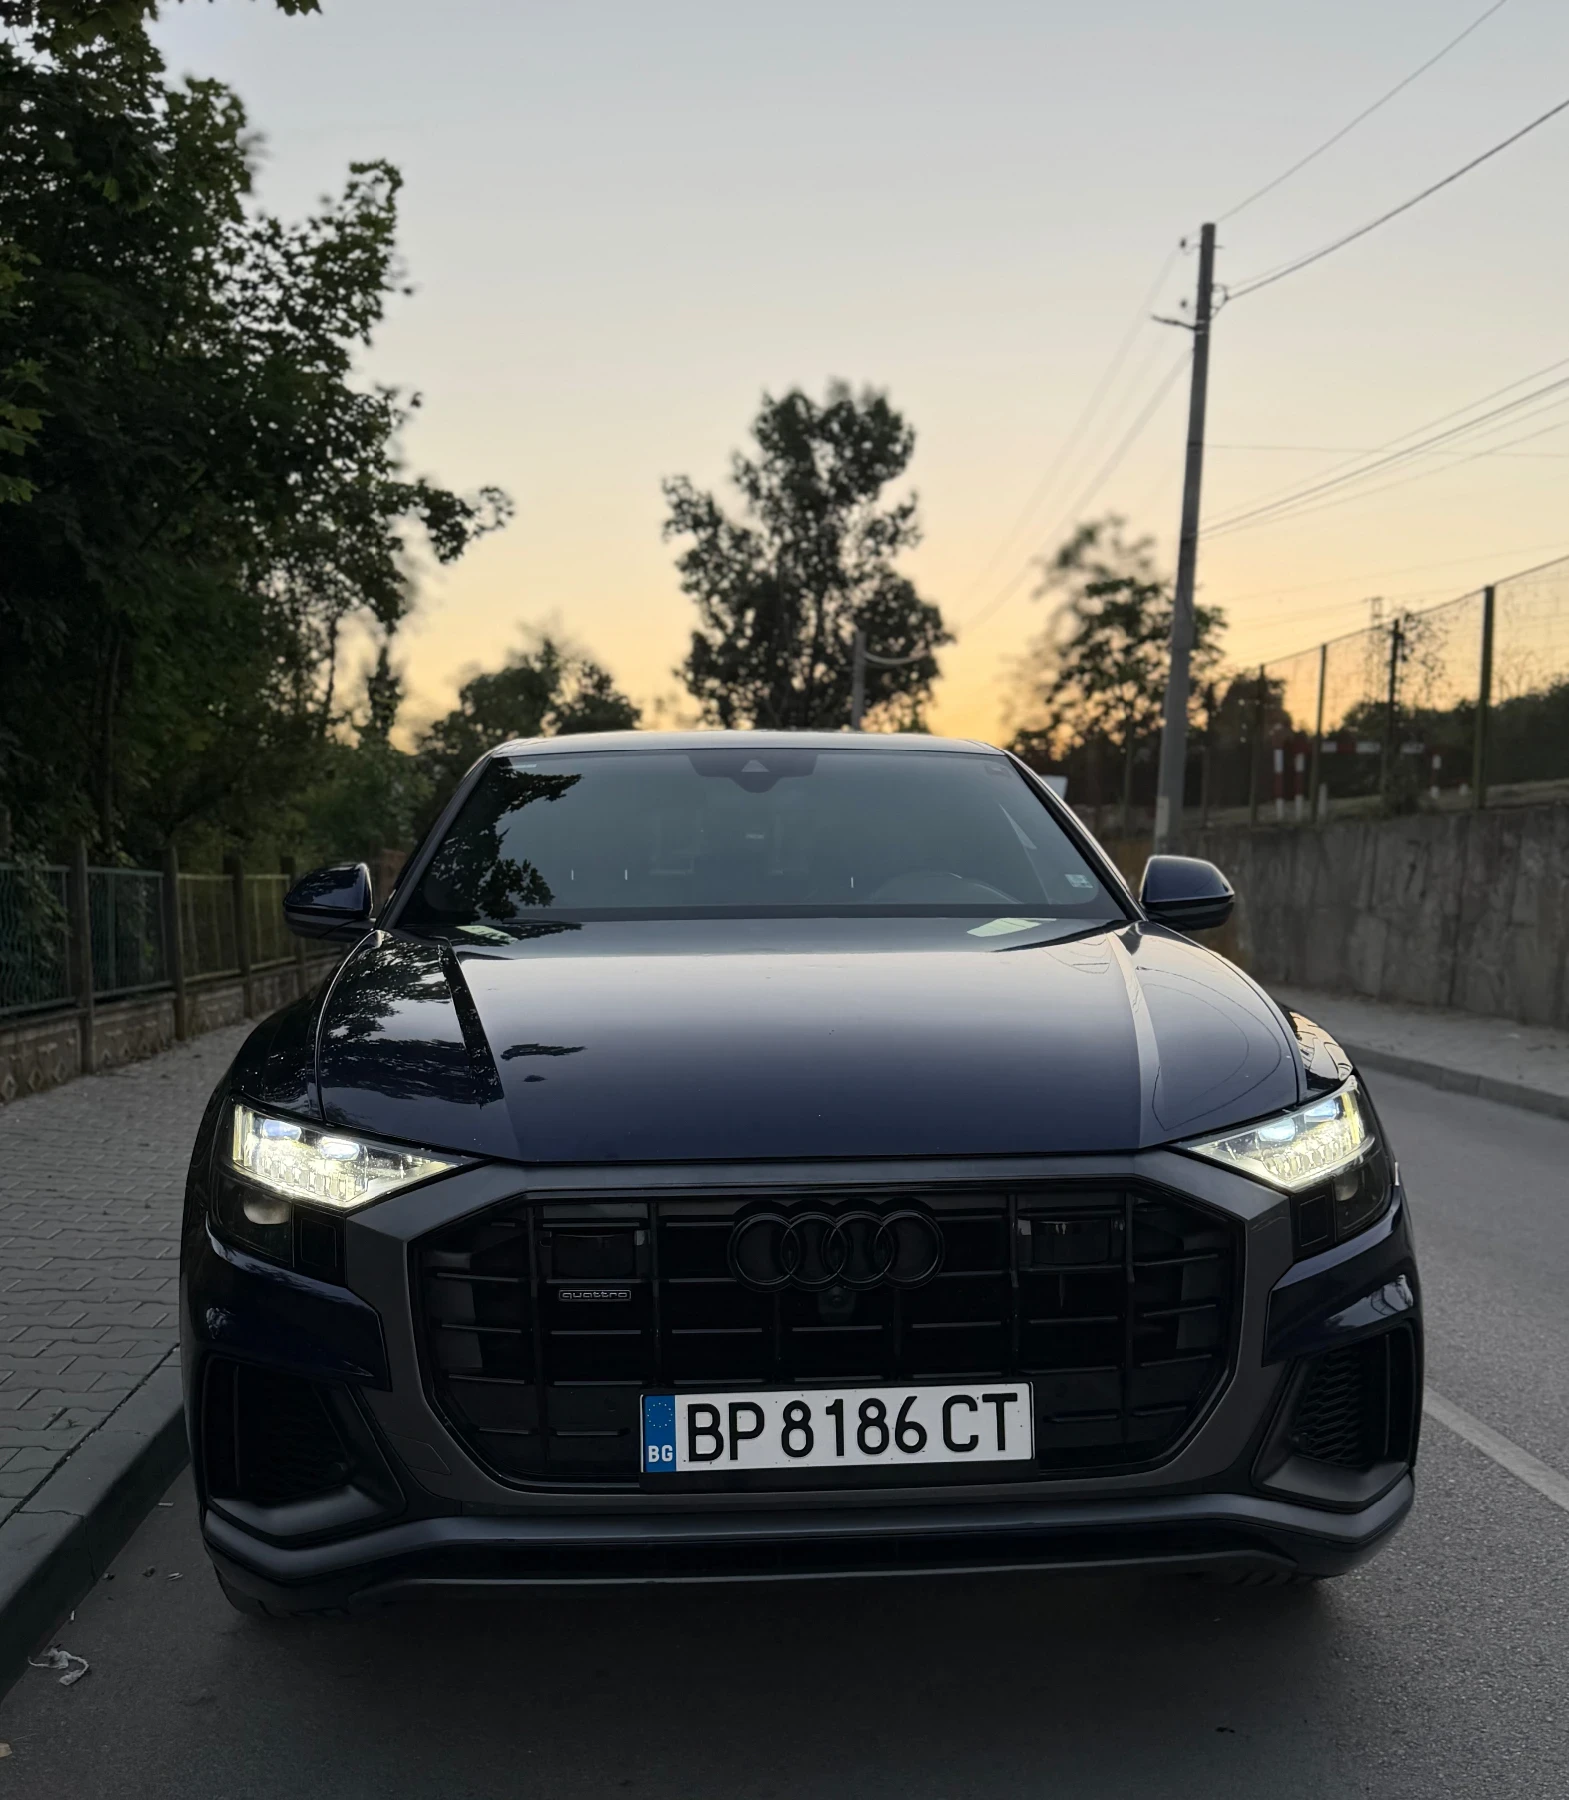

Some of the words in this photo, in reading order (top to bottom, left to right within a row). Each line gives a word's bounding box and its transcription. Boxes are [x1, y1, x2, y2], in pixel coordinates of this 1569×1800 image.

[562, 1291, 628, 1300] quattro
[687, 1401, 765, 1462] BP
[781, 1395, 928, 1458] 8186
[942, 1392, 1018, 1453] CT
[647, 1445, 674, 1463] BG
